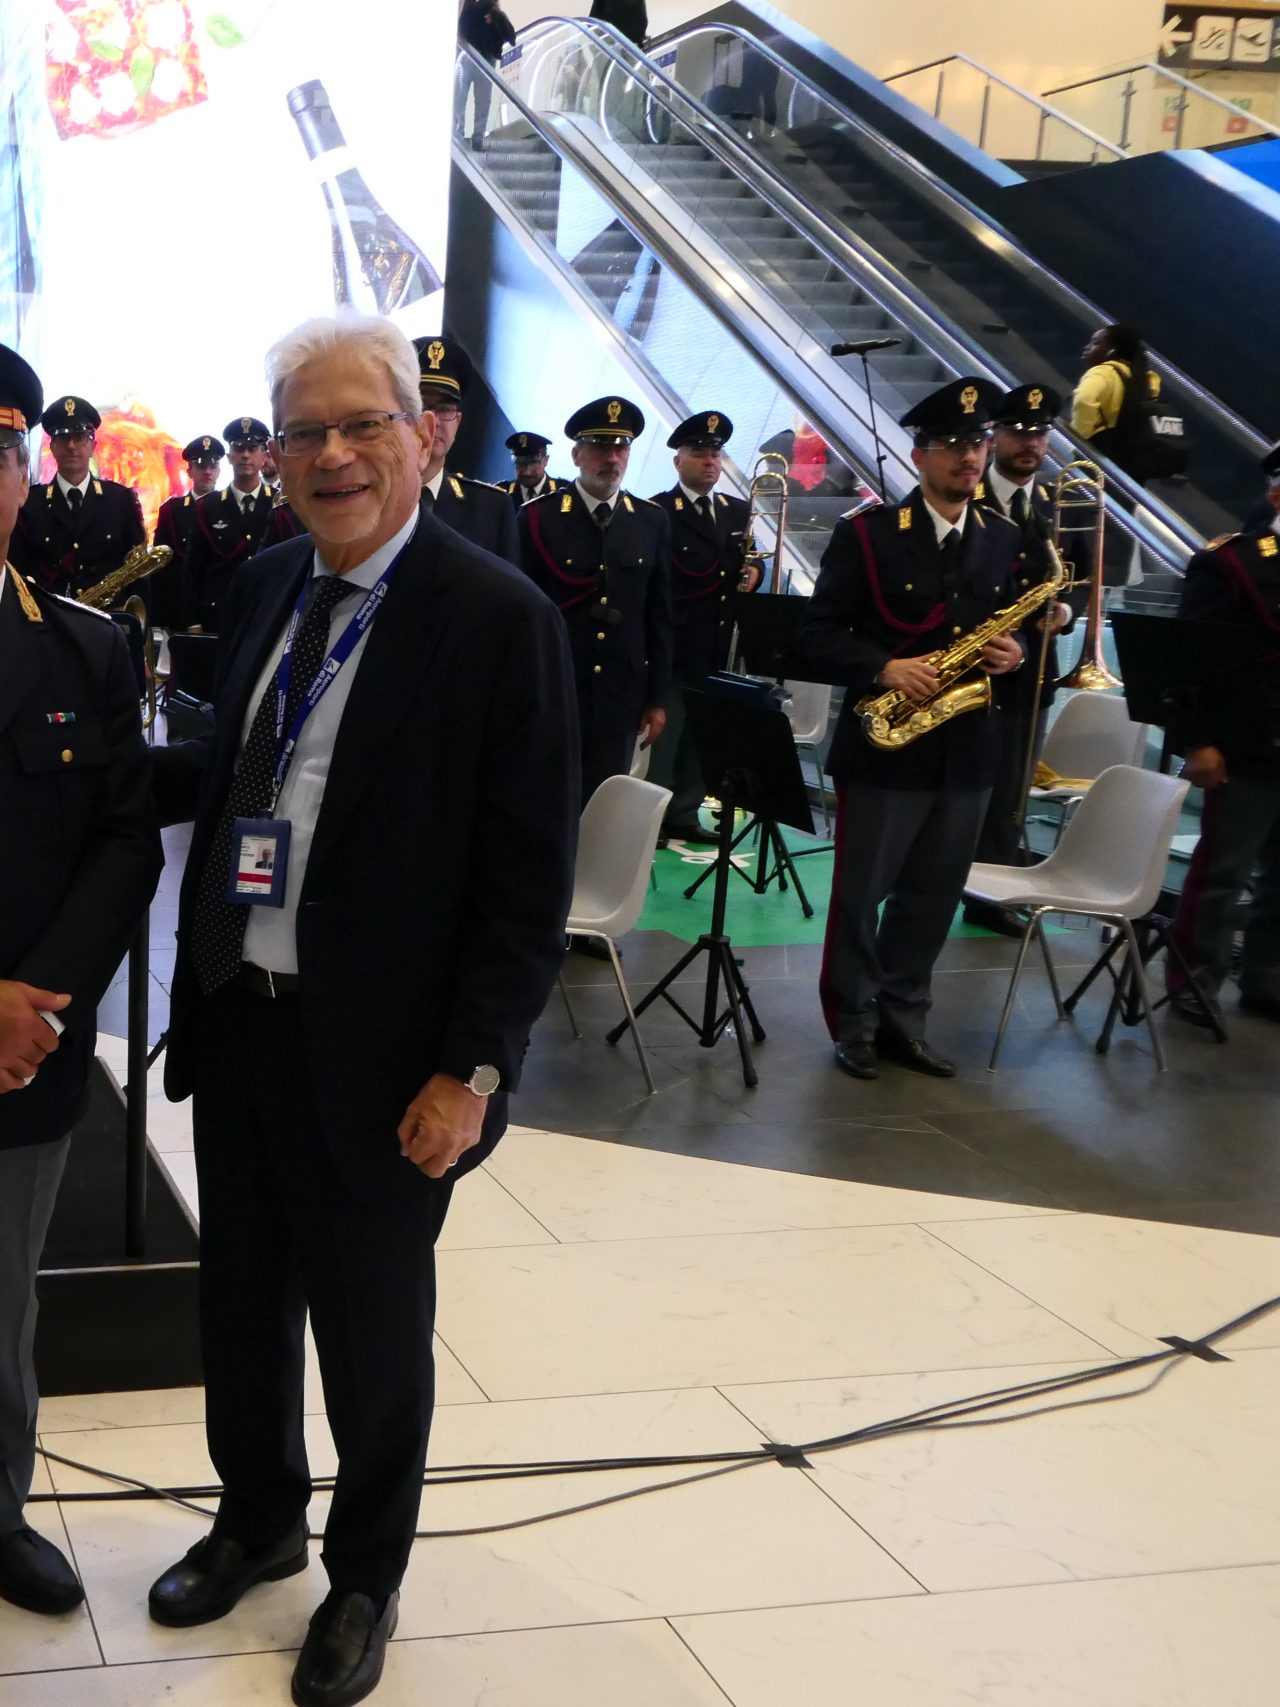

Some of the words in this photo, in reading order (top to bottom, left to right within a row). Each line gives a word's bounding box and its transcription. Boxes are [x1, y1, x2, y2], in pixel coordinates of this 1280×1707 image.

[356, 600, 372, 620] Roma
[358, 597, 382, 630] Aeroporti
[307, 677, 322, 697] Roma
[308, 673, 332, 706] Aeroporti
